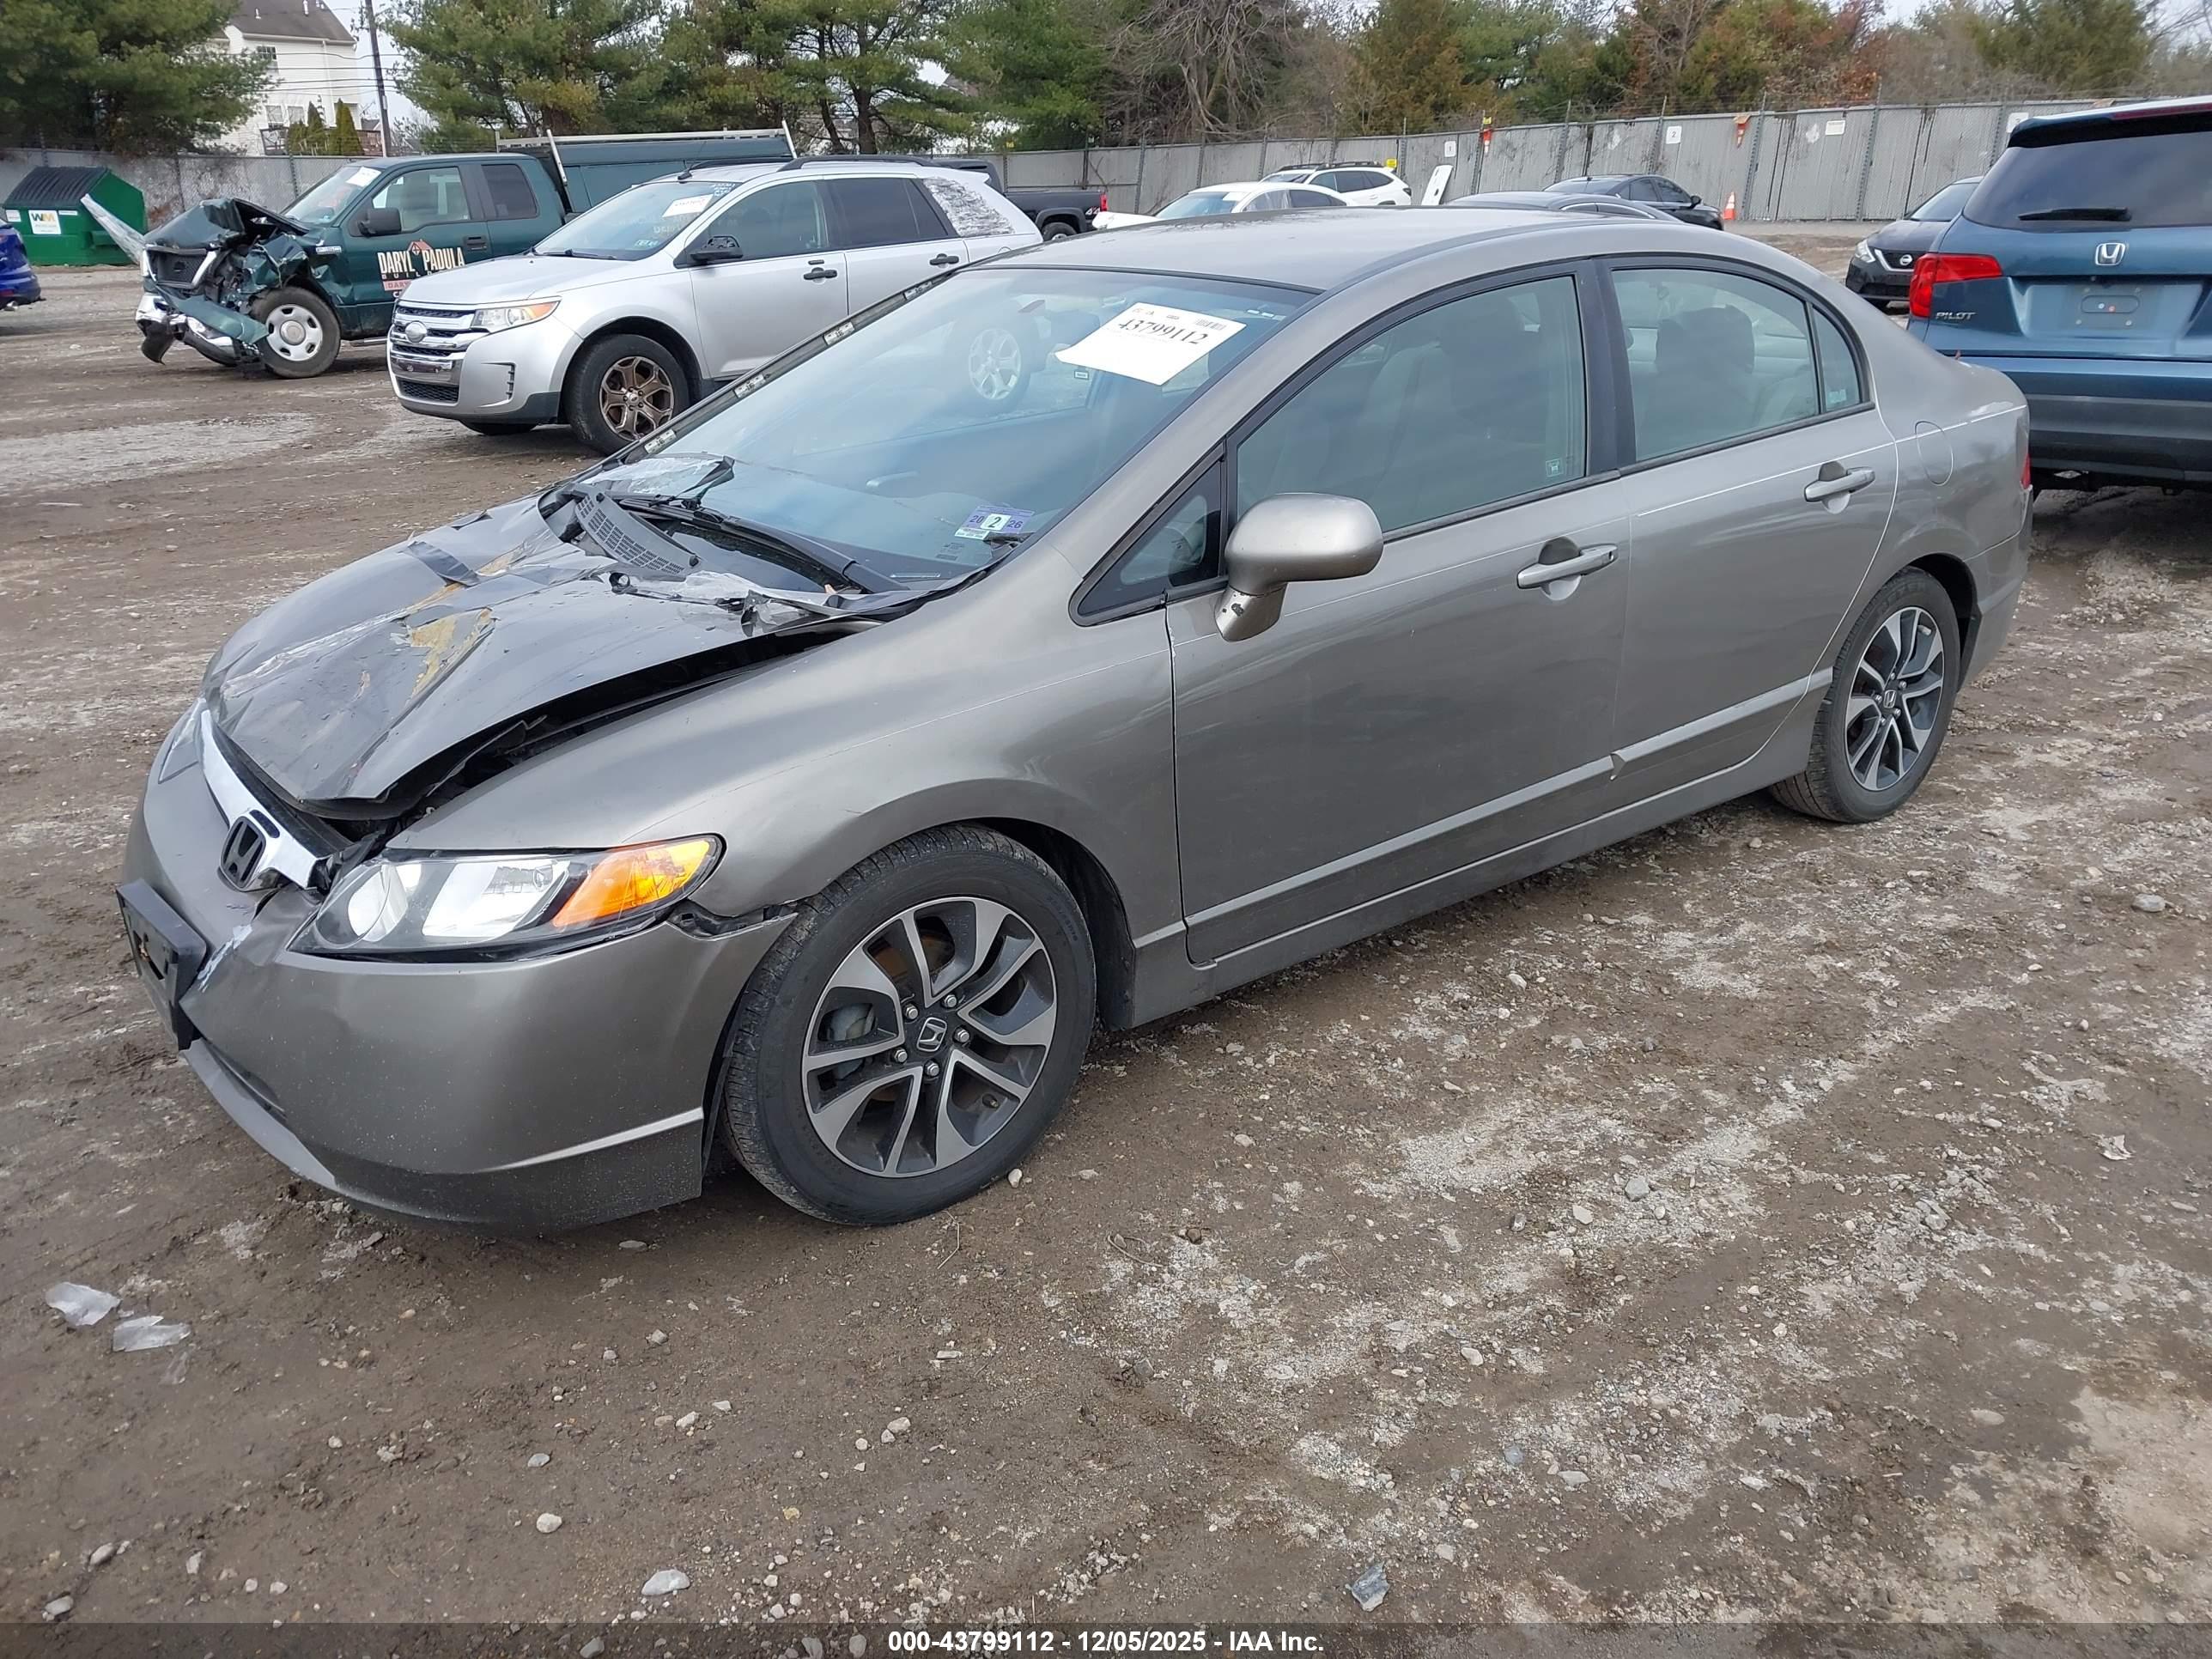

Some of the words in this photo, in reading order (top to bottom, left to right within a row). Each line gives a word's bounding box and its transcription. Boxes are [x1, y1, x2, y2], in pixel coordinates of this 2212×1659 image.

[31, 213, 56, 222] WM
[377, 250, 416, 274] DARYL
[421, 246, 465, 271] PADULA
[1936, 312, 1976, 320] PILOT
[1118, 318, 1209, 344] 43799112
[969, 515, 985, 524] 20
[988, 516, 1002, 528] 2
[1007, 520, 1024, 529] 26
